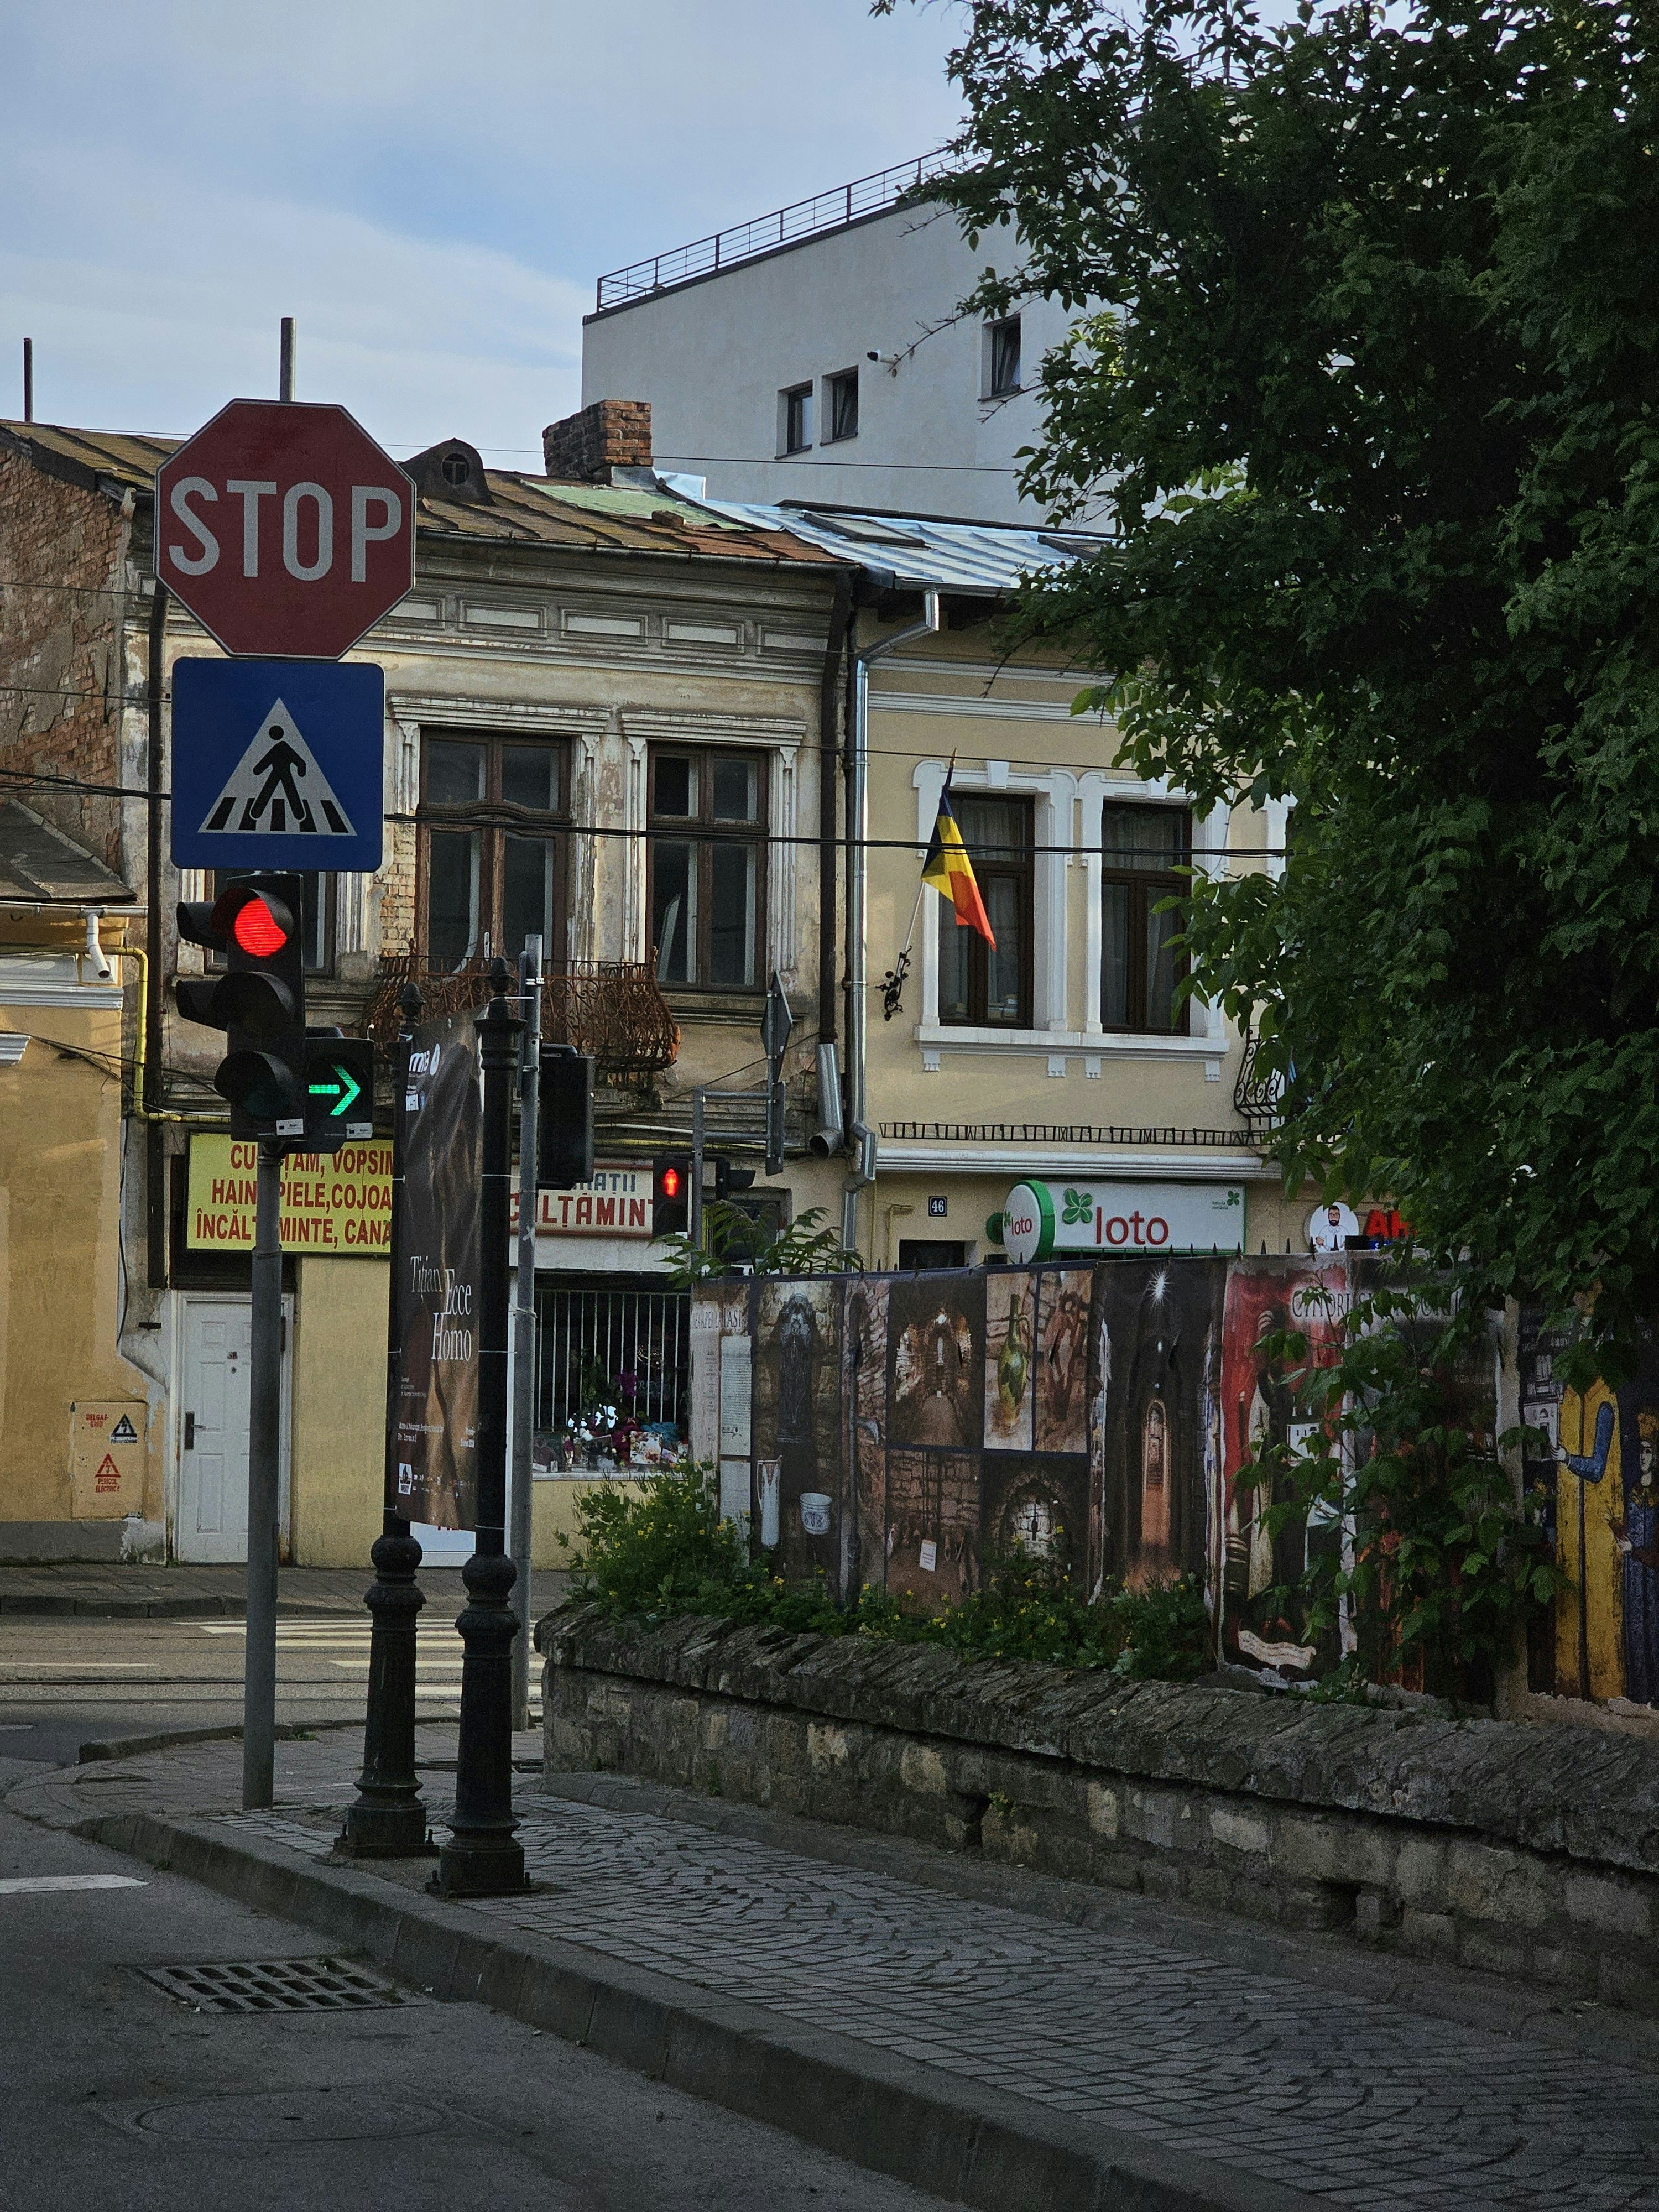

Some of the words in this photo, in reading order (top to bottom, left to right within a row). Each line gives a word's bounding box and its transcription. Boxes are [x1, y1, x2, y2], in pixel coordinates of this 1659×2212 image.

[169, 476, 402, 583] STOP
[212, 1179, 257, 1205] HAIN
[931, 1199, 945, 1213] 46
[1011, 1217, 1032, 1235] loto
[1096, 1206, 1169, 1245] loto
[444, 1269, 472, 1316] Ecce
[431, 1312, 472, 1362] Homo
